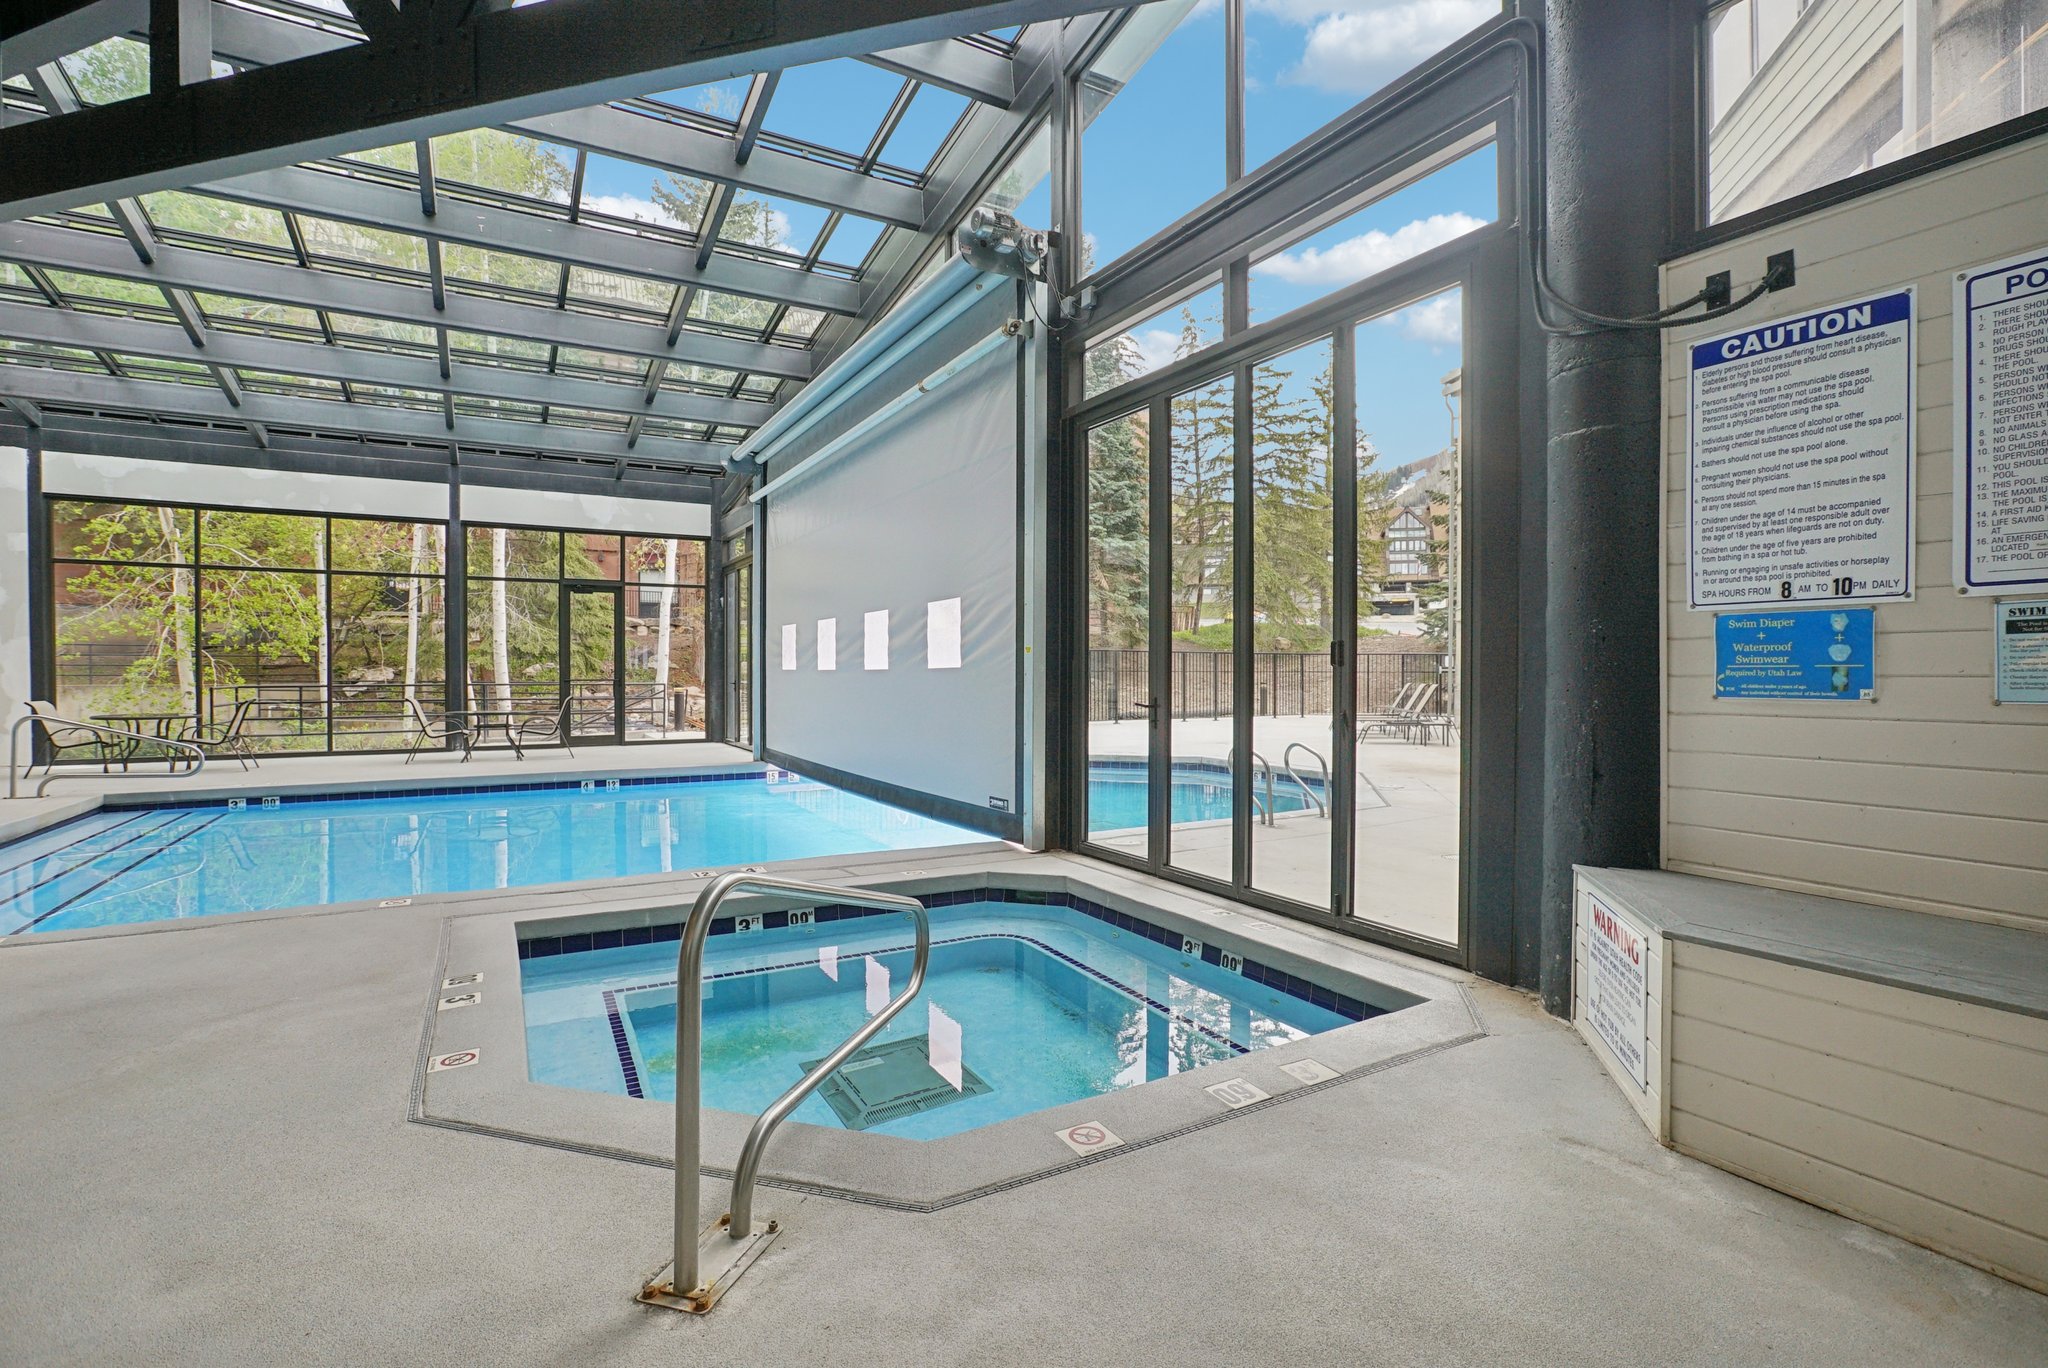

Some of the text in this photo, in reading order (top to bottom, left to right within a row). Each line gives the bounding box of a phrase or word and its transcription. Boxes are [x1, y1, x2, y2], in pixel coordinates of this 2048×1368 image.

[1993, 306, 2021, 318] THERE
[1994, 316, 2021, 327] THERE
[1721, 305, 1871, 359] CAUTION
[1993, 324, 2024, 336] ROUGH
[1993, 329, 2044, 346] NO PERSON
[1993, 342, 2024, 354] DRUGS
[1702, 331, 1888, 380] Elderly persons and those suffering from heart disease,
[1993, 352, 2021, 363] THERE
[1993, 358, 2038, 371] THE POOL.
[1993, 368, 2034, 381] PERSONS
[1993, 377, 2029, 389] SHOULD
[1993, 386, 2034, 399] PERSONS
[1993, 392, 2044, 407] INFECTIONS
[1993, 404, 2035, 416] PERSONS
[1993, 411, 2042, 425] NOT ENTER
[2008, 420, 2046, 432] ANIMALS
[1993, 431, 2038, 444] NO GLASS
[1702, 459, 1726, 468] Bathers
[1728, 454, 1749, 463] should
[1751, 452, 1762, 460] not
[1791, 446, 1804, 454] spa
[1806, 442, 1822, 452] pool
[1824, 440, 1848, 448] alone.
[1993, 471, 2019, 479] POOL.
[1992, 481, 2011, 489] THIS
[2014, 478, 2038, 486] POOL
[2012, 497, 2036, 505] POOL
[1701, 517, 1728, 525] Children
[1730, 514, 1748, 522] under
[1798, 506, 1815, 514] must
[1829, 498, 1881, 510] accompanied
[2000, 507, 2023, 516] FIRST
[1702, 526, 1714, 534] and
[1715, 522, 1750, 532] supervised
[1752, 521, 1761, 529] by
[1762, 519, 1768, 527] at
[1770, 518, 1788, 526] least
[1805, 511, 1848, 523] responsible
[1850, 508, 1870, 517] adult
[1992, 515, 2044, 526] LIFE SAVING
[1777, 540, 1784, 548] of
[1801, 538, 1821, 547] years
[1838, 532, 1877, 544] prohibited
[1991, 543, 2029, 552] LOCATED
[1738, 565, 1770, 575] engaging
[1780, 562, 1804, 571] unsafe
[1806, 560, 1839, 568] activities
[1851, 556, 1890, 565] horseplay
[1702, 577, 1900, 598] SPA HOURS FROM 8 AM TO 10 PM DAILY
[1729, 618, 1795, 629] Swim Diaper
[1733, 642, 1792, 653] Waterproof
[1736, 655, 1789, 664] Swimwear
[1593, 904, 1639, 965] WARNING
